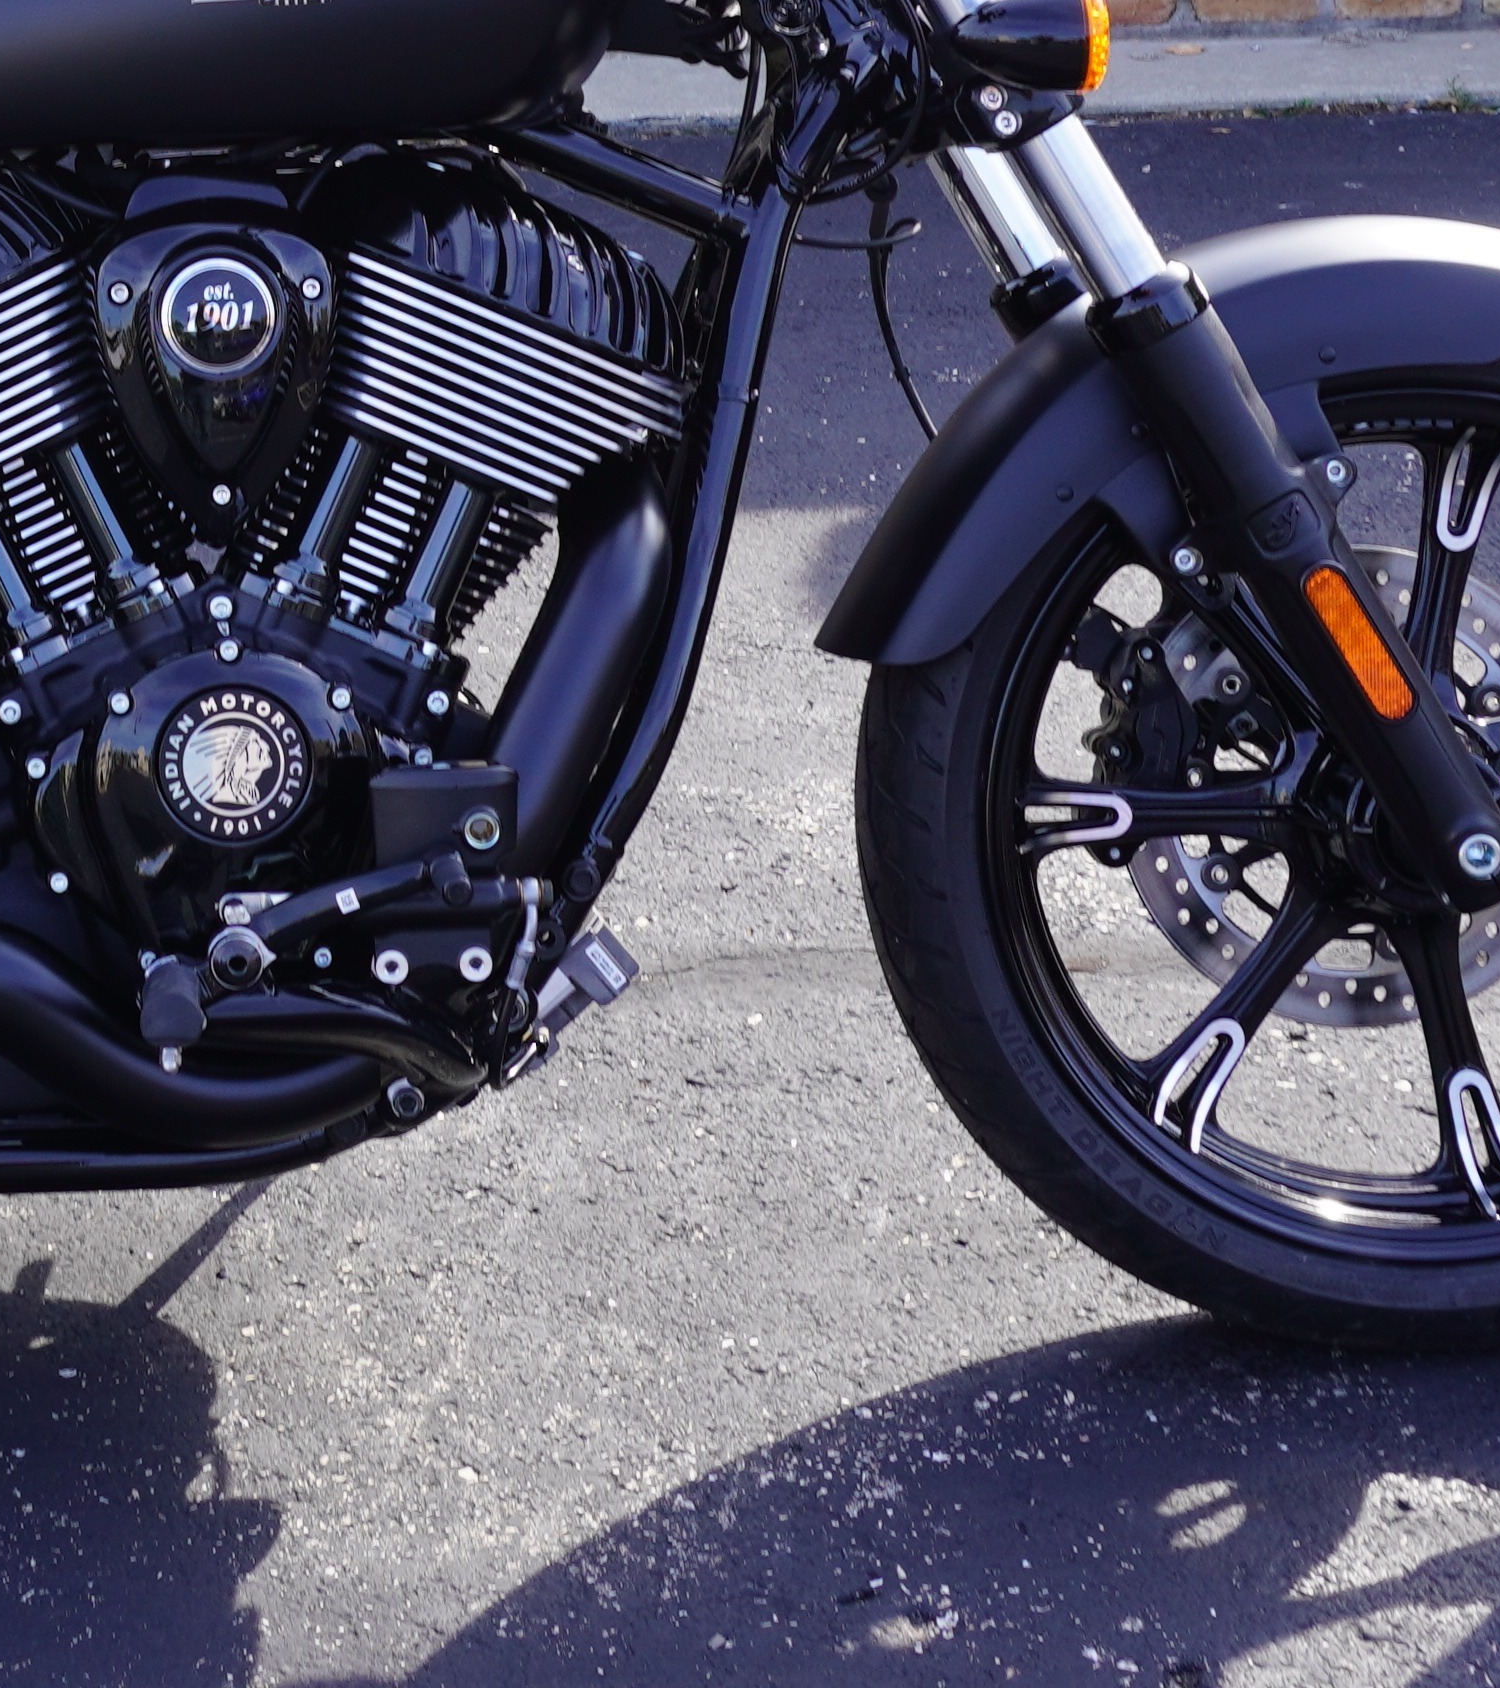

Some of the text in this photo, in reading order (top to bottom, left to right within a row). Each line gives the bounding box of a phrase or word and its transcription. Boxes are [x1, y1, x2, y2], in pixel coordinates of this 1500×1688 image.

[203, 280, 235, 301] est.
[183, 299, 255, 333] 1901
[163, 692, 304, 812] INDIAN MOTORCYCLE
[210, 815, 262, 836] 1901
[989, 1006, 1072, 1123] NIGHT
